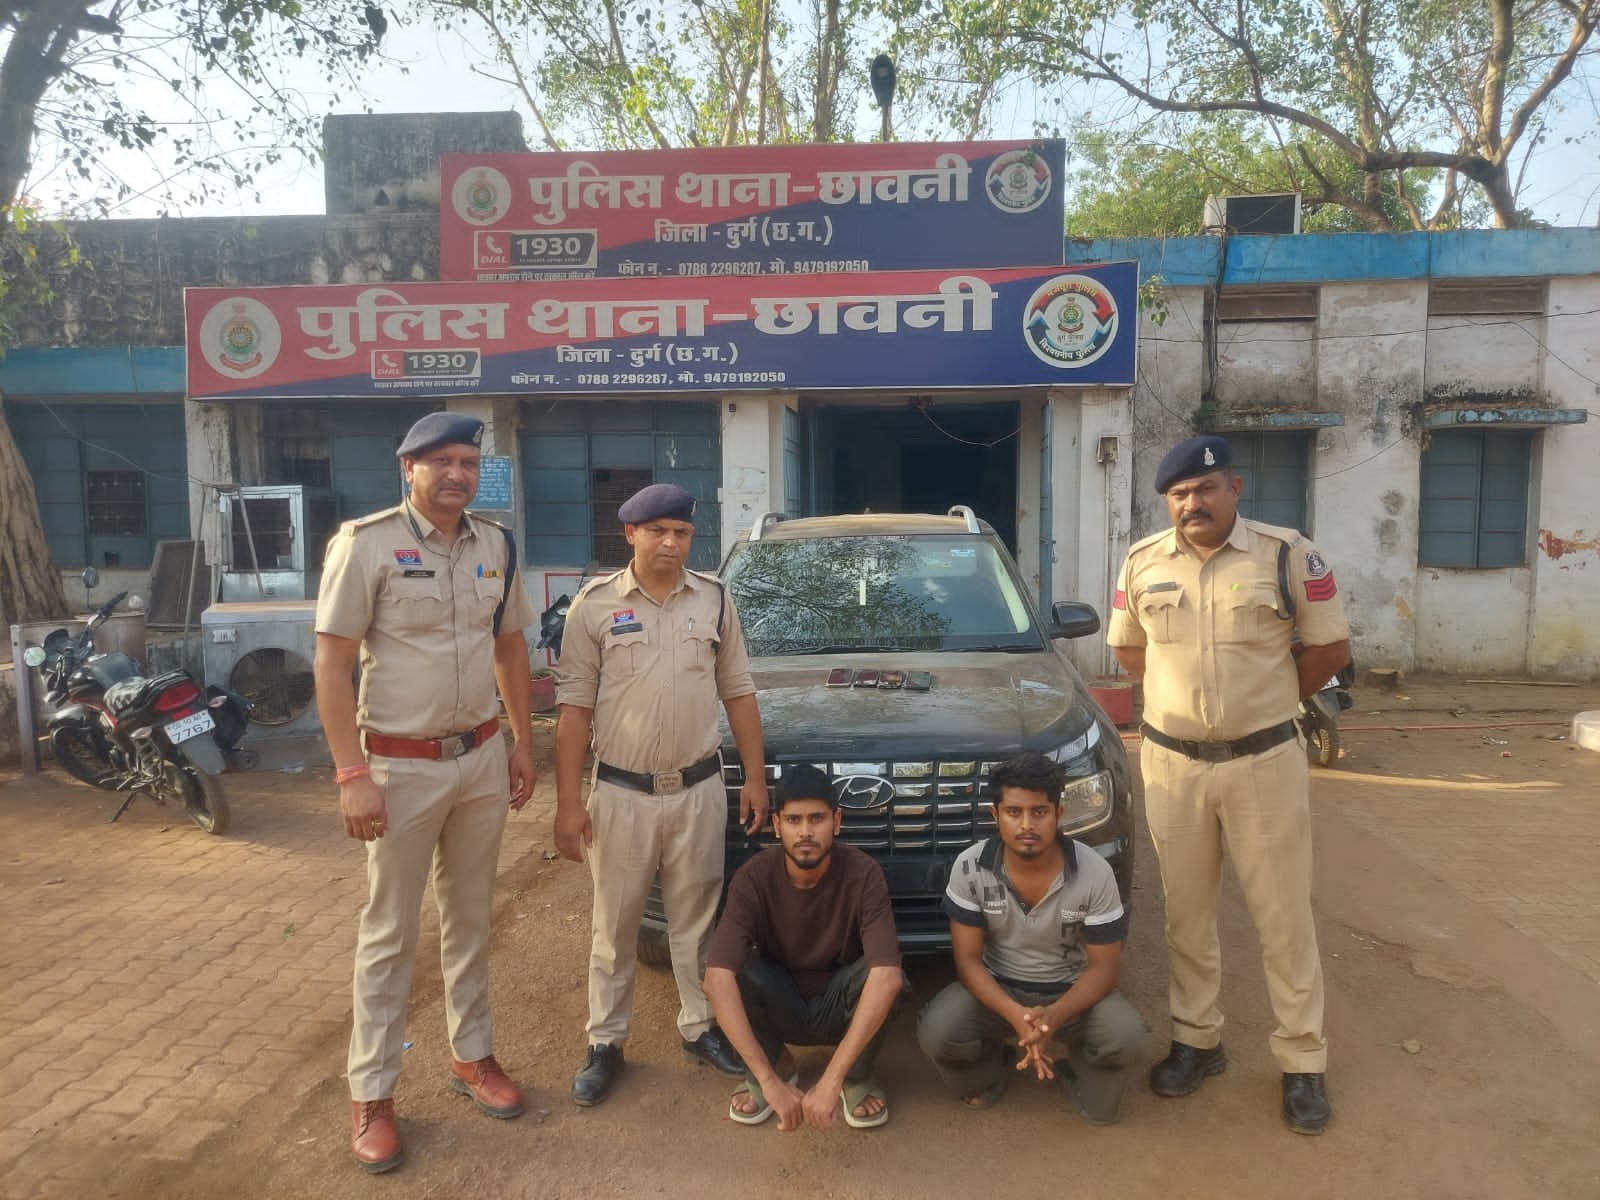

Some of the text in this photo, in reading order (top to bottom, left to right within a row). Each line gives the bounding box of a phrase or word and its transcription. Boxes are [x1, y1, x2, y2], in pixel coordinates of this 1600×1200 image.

[528, 152, 972, 225] पुलिस थाना-छावनी
[654, 218, 709, 243] जिला
[726, 216, 758, 248] दुर्ग
[762, 215, 833, 247] (छ.ग.)
[516, 237, 581, 256] 1930
[618, 259, 644, 275] फोन
[679, 262, 708, 276] 0788
[297, 275, 998, 360] पुलिस थाना-छावनी
[409, 353, 467, 369] 1930
[556, 345, 612, 363] जिला
[629, 343, 662, 367] दुर्ग
[665, 342, 739, 366] (छ.ग.)
[511, 372, 540, 385] फोन
[578, 374, 609, 385] 0788
[704, 371, 786, 383] 9479192050
[172, 719, 210, 741] 7767
